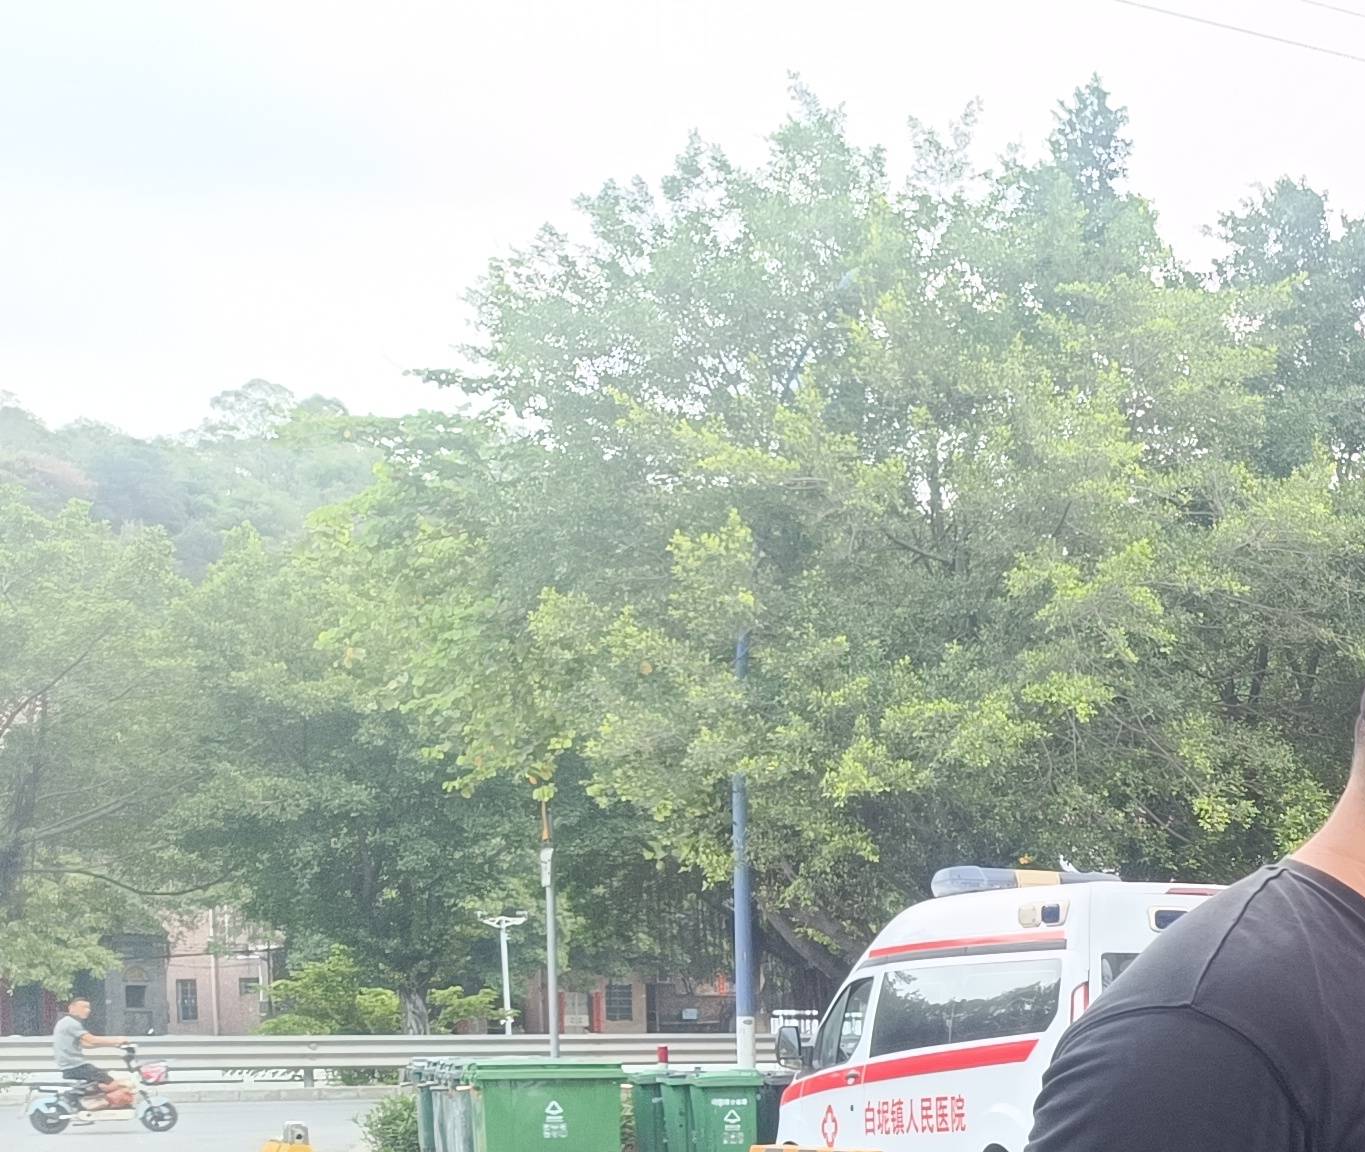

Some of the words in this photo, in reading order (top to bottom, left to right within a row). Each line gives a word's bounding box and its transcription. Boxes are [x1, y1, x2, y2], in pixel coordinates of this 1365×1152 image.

[865, 1094, 966, 1135] 白坭镇人民医院
